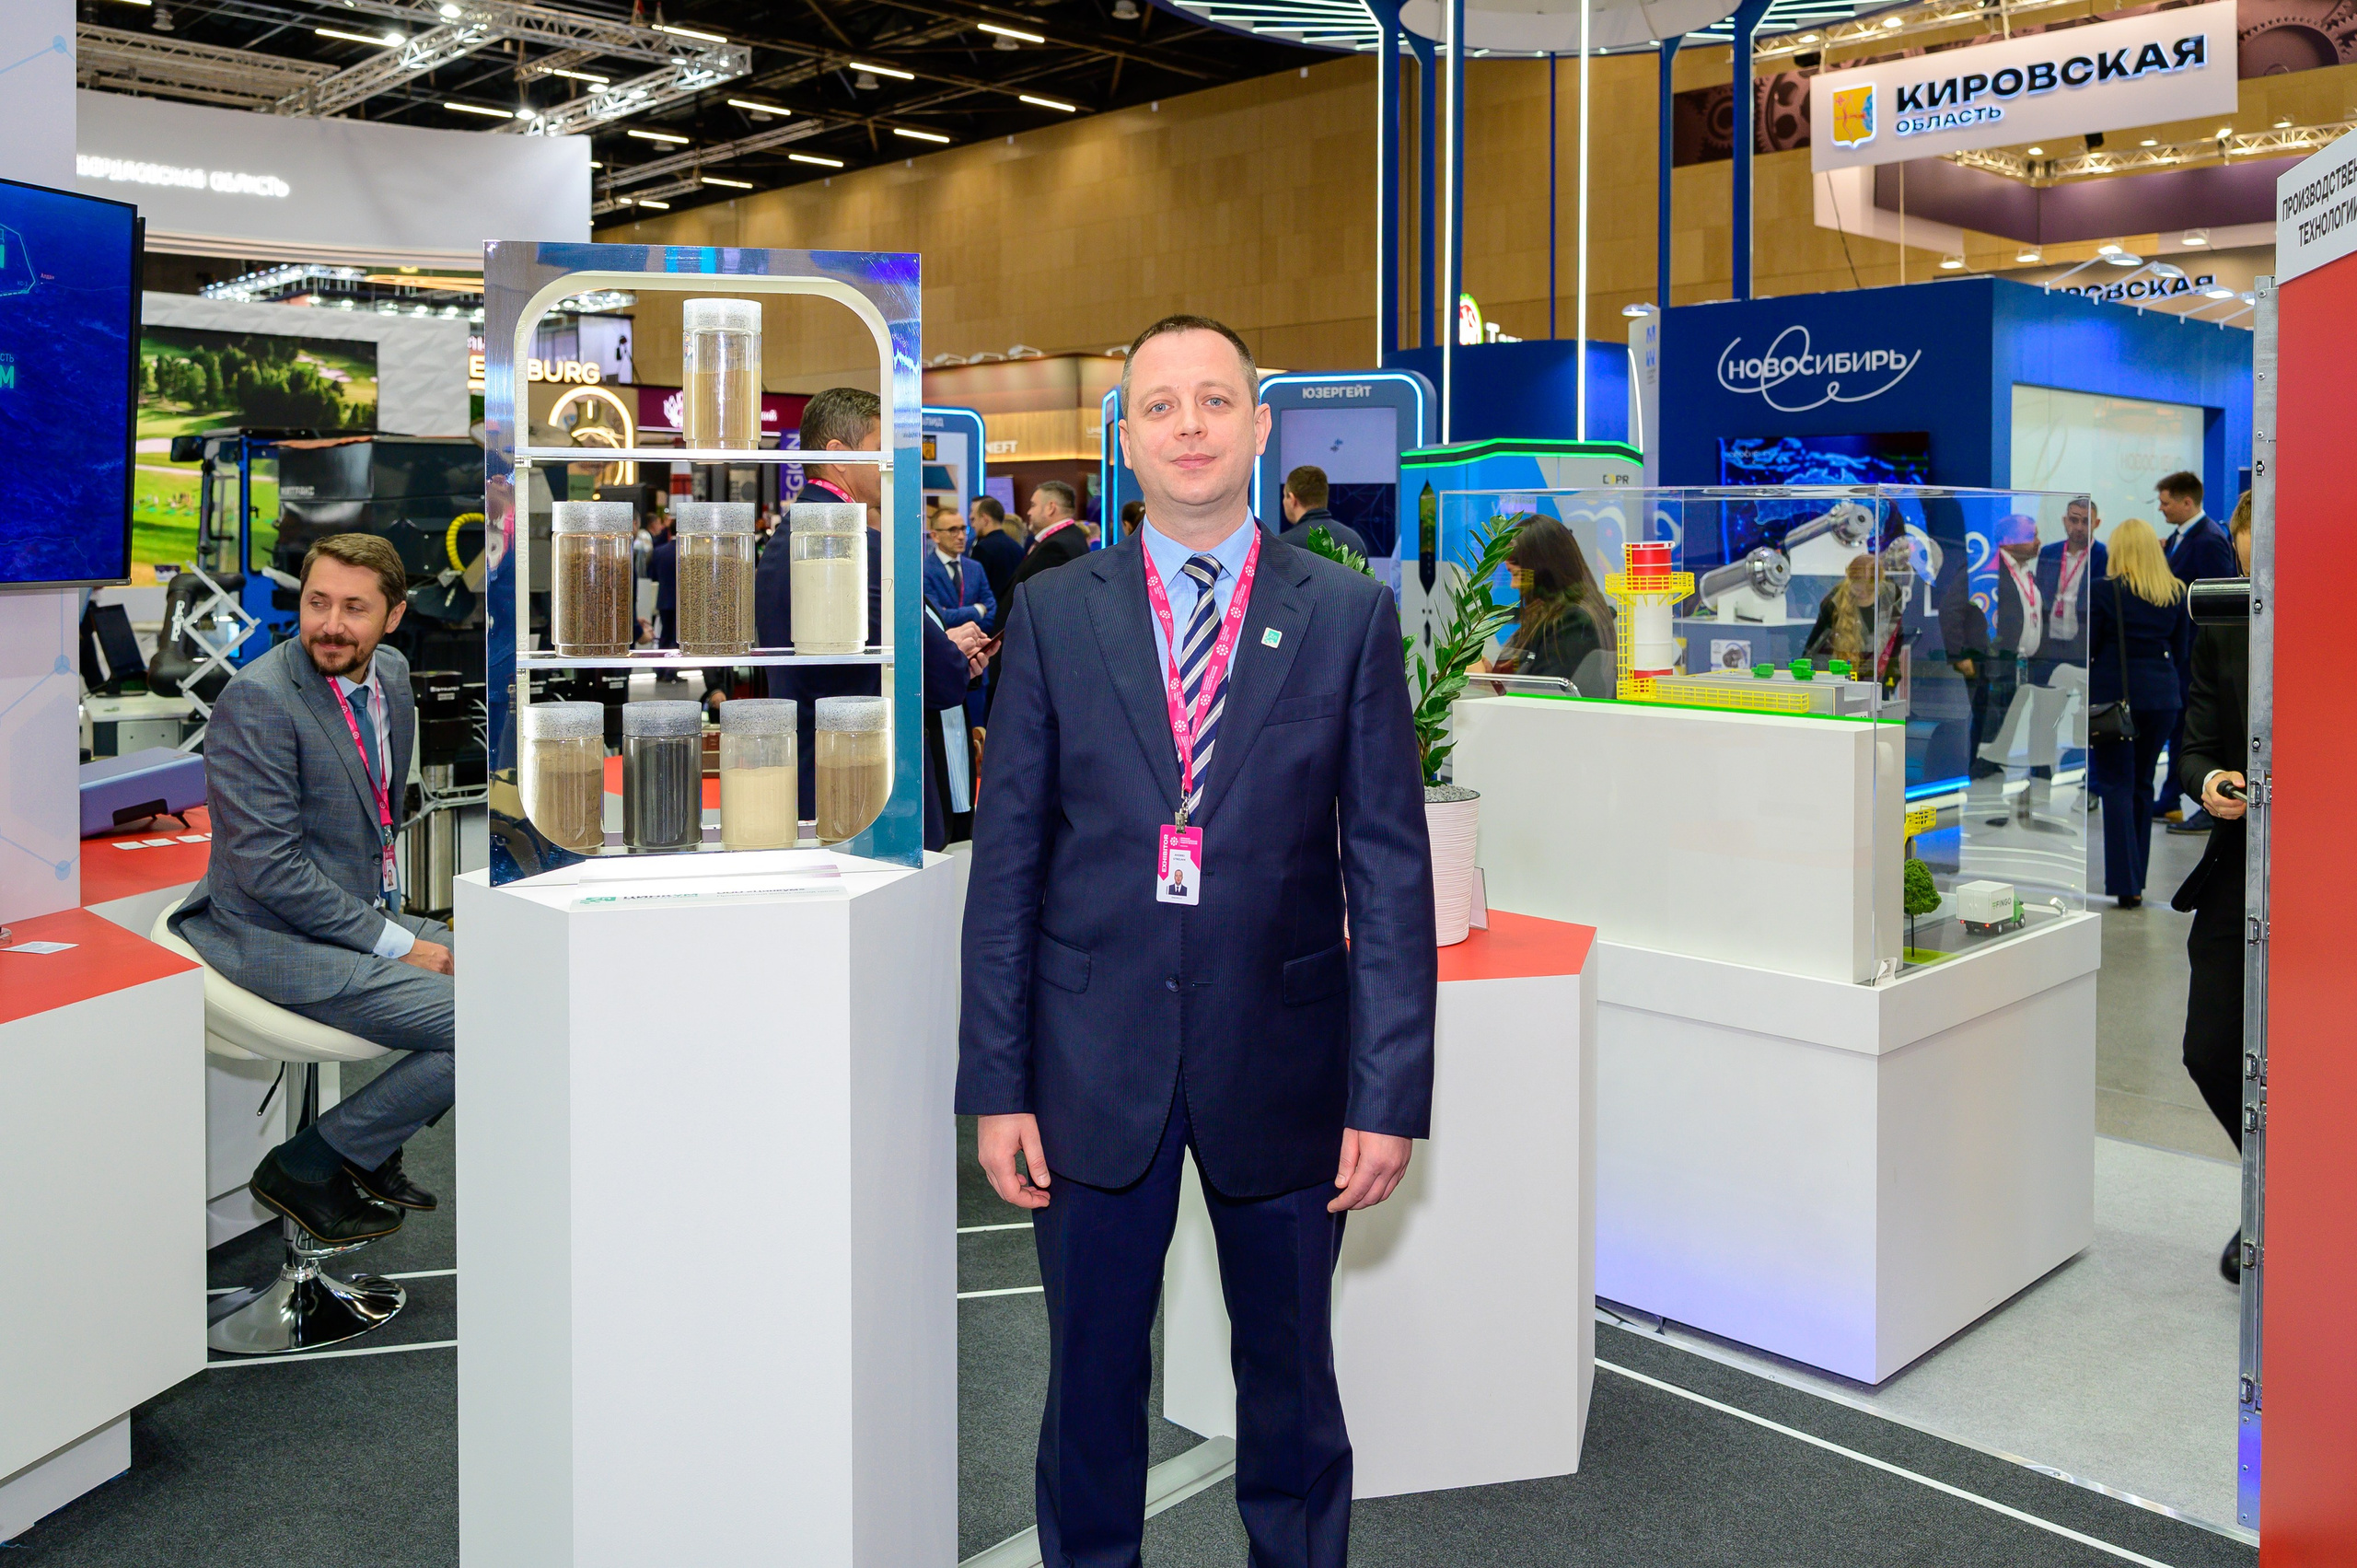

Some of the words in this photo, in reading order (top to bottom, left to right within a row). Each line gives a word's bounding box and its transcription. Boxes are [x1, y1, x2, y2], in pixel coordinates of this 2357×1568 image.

[1897, 33, 2207, 114] КИРОВСКАЯ
[1896, 105, 2004, 135] ОБЛАСТЬ
[1727, 349, 1907, 380] НОВОСИБИРЬ
[1302, 384, 1372, 399] ЮЗЕРГЕЙТ
[1161, 834, 1169, 873] EXHIBITOR
[1996, 898, 2011, 908] FINGO
